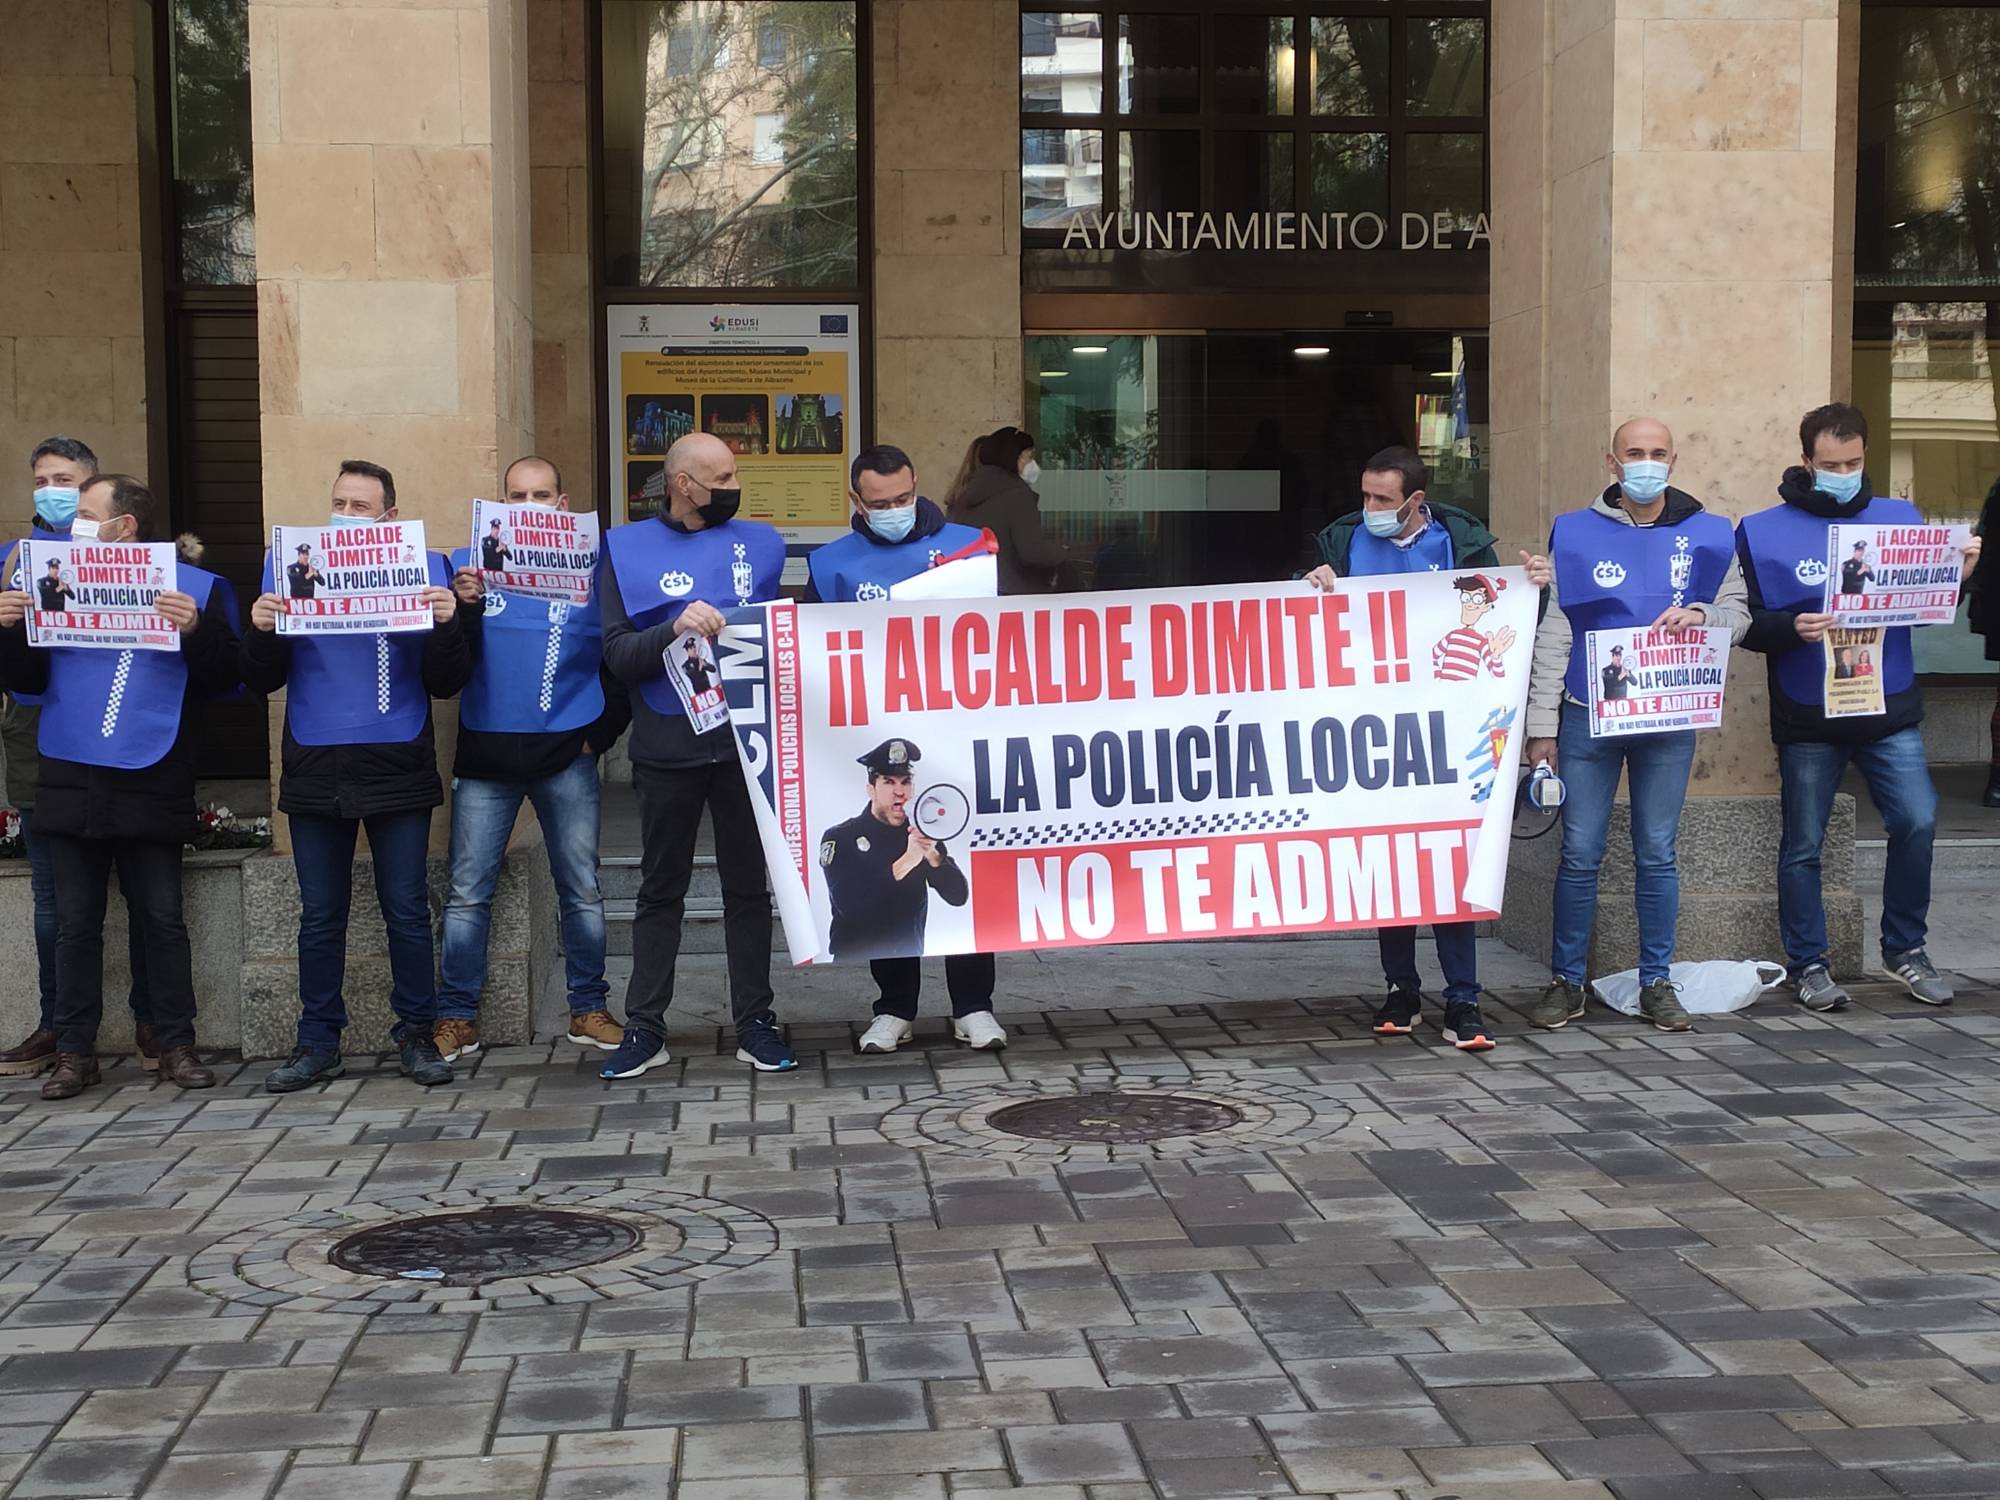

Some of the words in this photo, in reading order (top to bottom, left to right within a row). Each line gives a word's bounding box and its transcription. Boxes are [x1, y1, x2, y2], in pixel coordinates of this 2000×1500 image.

[1063, 211, 1385, 250] AYUNTAMIENTO
[1401, 212, 1452, 249] DE
[728, 318, 759, 326] EDUSI
[521, 510, 577, 532] ALCALDE
[335, 526, 403, 548] ALCALDE
[514, 528, 562, 548] DIMITE
[565, 534, 574, 550] !!
[1890, 528, 1951, 546] ALCALDE
[85, 547, 152, 565] ALCALDE
[327, 548, 384, 568] DIMITE
[388, 547, 399, 564] !!
[514, 549, 526, 566] LA
[528, 550, 568, 569] POLICÍA
[1880, 548, 1929, 565] DIMITE
[1932, 547, 1943, 564] !!
[77, 567, 132, 585] DIMITE
[136, 567, 147, 585] !!
[326, 572, 342, 590] LA
[344, 566, 391, 590] POLICÍA
[392, 567, 426, 587] LOCAL
[482, 570, 507, 586] NO
[509, 572, 531, 586] TE
[535, 573, 592, 591] ADMIT
[1596, 566, 1623, 578] CSL
[1799, 565, 1826, 576] CSL
[1876, 569, 1889, 587] LA
[1890, 566, 1930, 586] POLICÍA
[1930, 566, 1958, 584] LOCAL
[663, 576, 691, 588] CSL
[76, 587, 91, 606] LA
[94, 585, 138, 606] POLICÍA
[486, 596, 503, 608] SL
[859, 586, 885, 601] CSL
[1838, 594, 1863, 610] NO
[1868, 594, 1888, 609] TE
[1891, 590, 1952, 609] ADMITE
[290, 599, 317, 616] NO
[320, 598, 344, 615] TE
[350, 594, 428, 613] ADMITE
[41, 610, 67, 628] NO
[71, 612, 95, 629] TE
[99, 612, 174, 632] ADMITE
[776, 611, 794, 648] C-LM
[1646, 628, 1708, 646] ALCALDE
[1827, 627, 1878, 646] WANTED
[826, 630, 869, 727] ¡¡
[884, 606, 1136, 713] ALCALDE
[1150, 594, 1356, 698] DIMITE
[1367, 590, 1411, 684] !!
[1640, 648, 1686, 668] DIMITE
[1690, 647, 1700, 664] !!
[778, 650, 797, 711] LOCALES
[1638, 672, 1654, 690] LA
[1656, 666, 1690, 688] POLICÍA
[1691, 668, 1722, 686] LOCAL
[695, 688, 721, 712] NO
[1603, 699, 1630, 718] NO
[1632, 696, 1658, 714] TE
[1660, 692, 1718, 712] ADMITE
[781, 709, 799, 780] POLICIAS
[972, 737, 1041, 815] LA
[1052, 709, 1273, 810] POLICÍA
[1284, 710, 1458, 794] LOCAL
[1016, 852, 1116, 943] NO
[1130, 846, 1217, 934] TE
